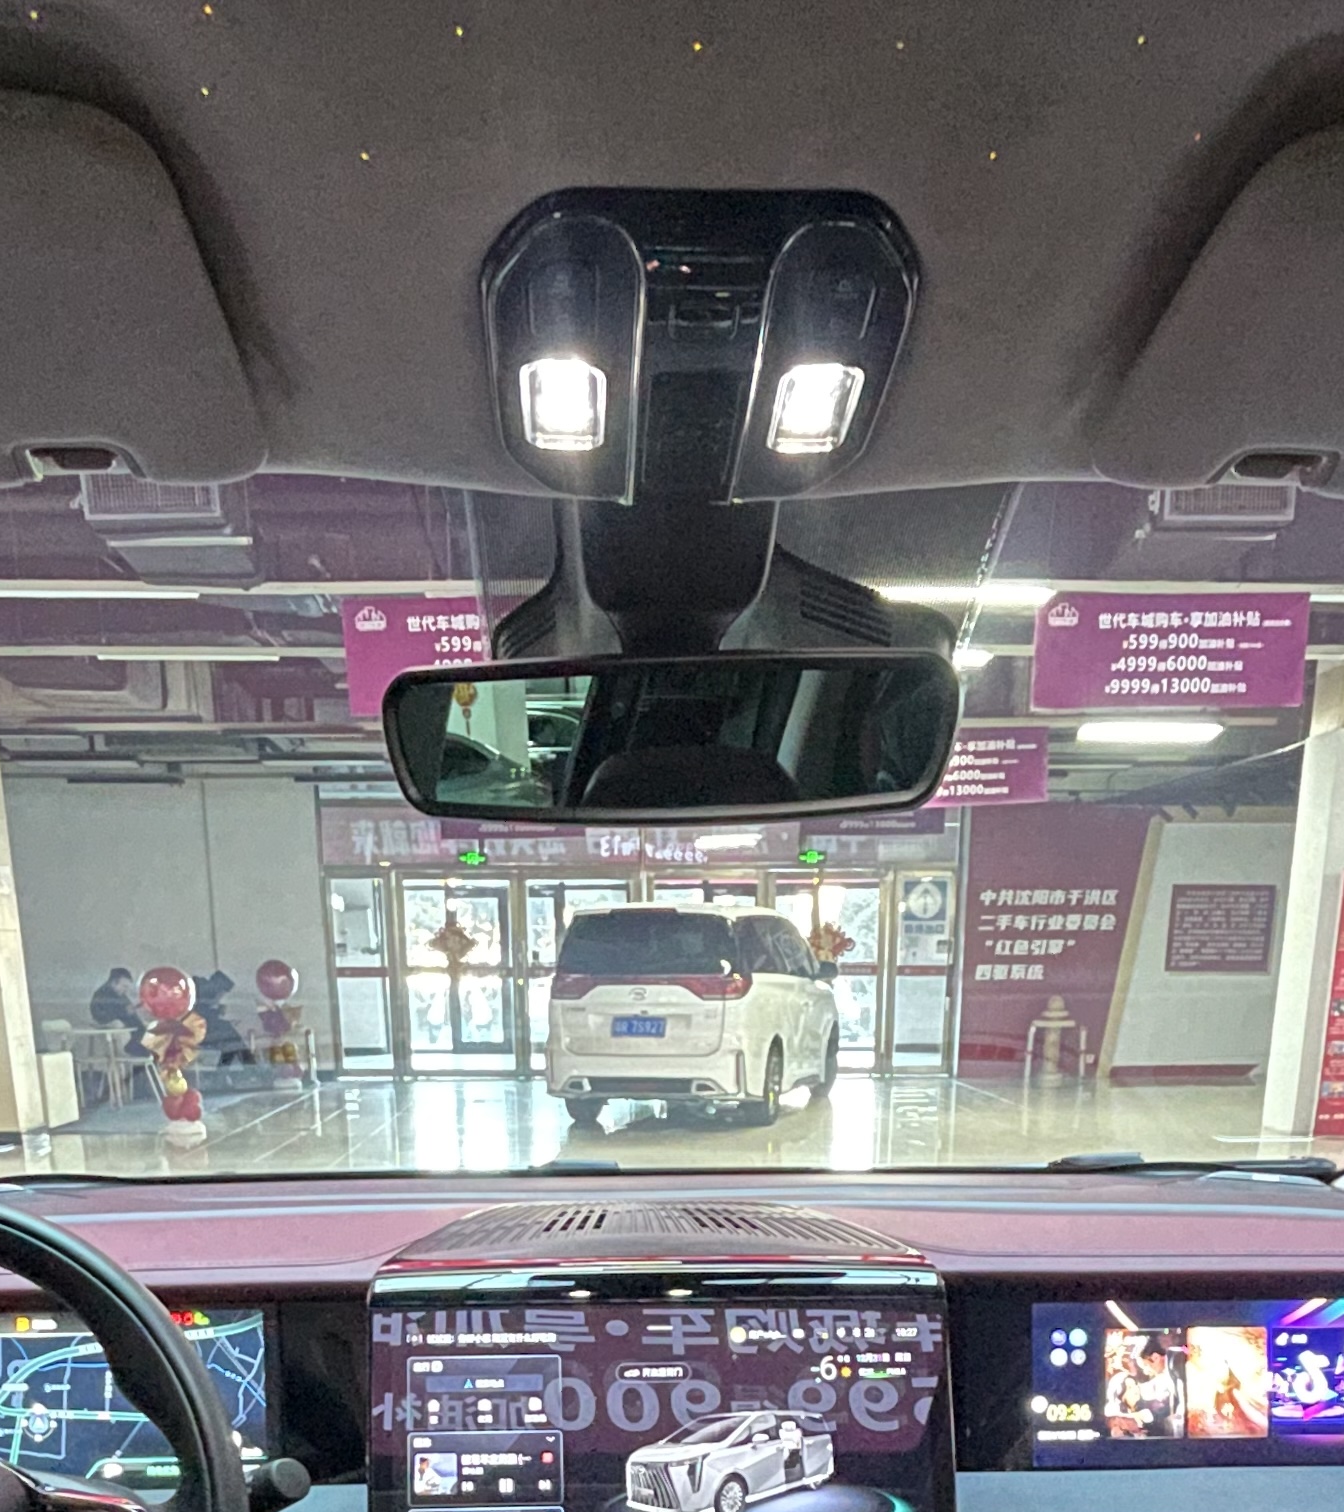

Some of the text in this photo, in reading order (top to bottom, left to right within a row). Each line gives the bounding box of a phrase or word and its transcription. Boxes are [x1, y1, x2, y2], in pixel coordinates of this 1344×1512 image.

[978, 888, 1120, 907] 中共沈阳市于洪区
